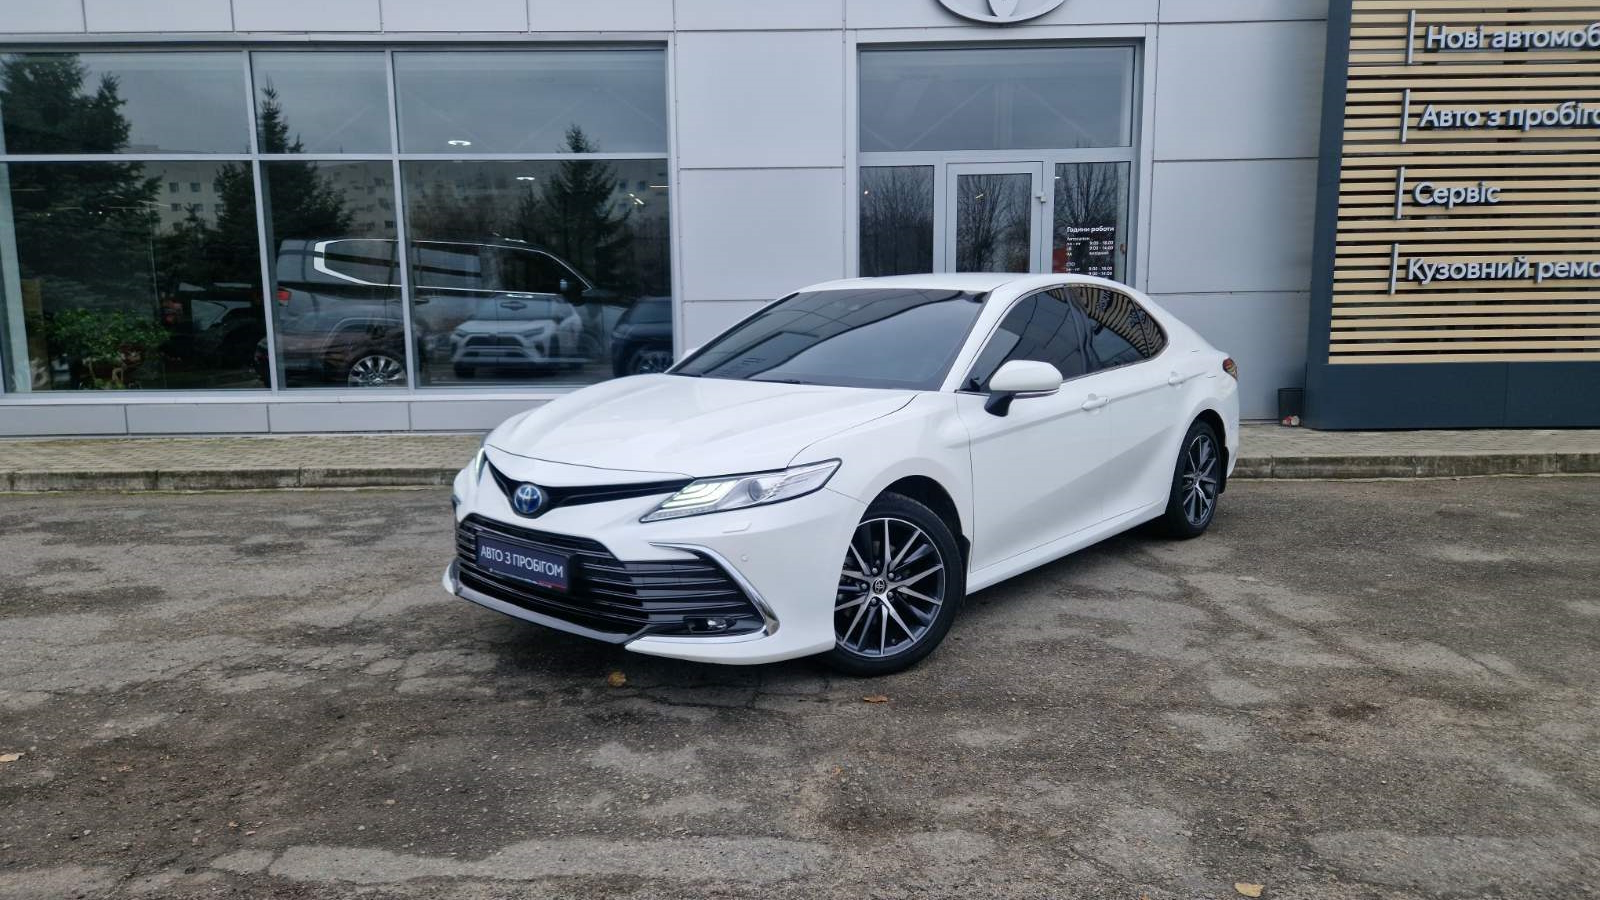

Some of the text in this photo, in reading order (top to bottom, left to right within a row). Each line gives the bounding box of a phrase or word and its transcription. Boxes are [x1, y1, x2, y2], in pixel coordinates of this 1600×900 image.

[1426, 25, 1484, 49] Нові
[1419, 104, 1481, 127] Авто
[1486, 110, 1500, 126] з
[1414, 181, 1500, 209] Сервіс
[1091, 225, 1114, 233] роботи
[1408, 255, 1529, 285] Кузовний
[480, 545, 504, 562] АВТО
[512, 554, 564, 579] ПРОБІГОМ
